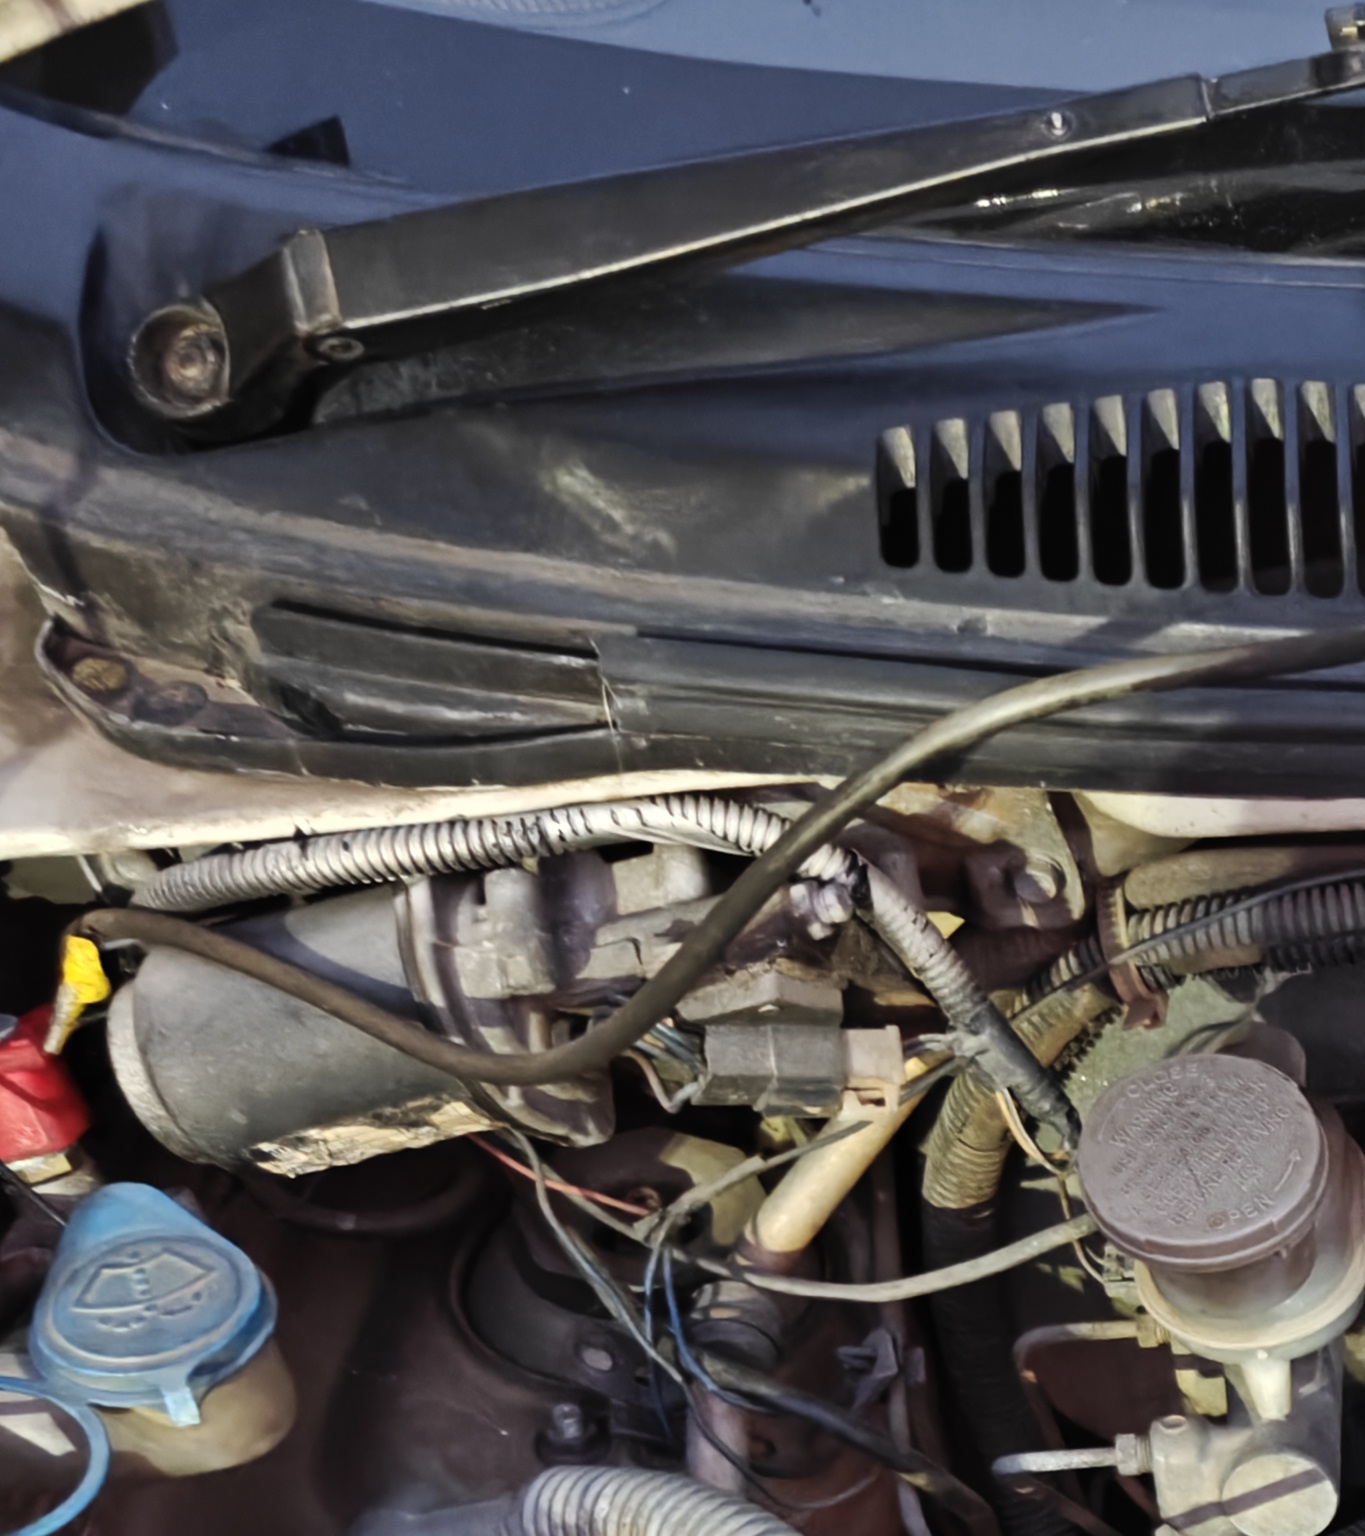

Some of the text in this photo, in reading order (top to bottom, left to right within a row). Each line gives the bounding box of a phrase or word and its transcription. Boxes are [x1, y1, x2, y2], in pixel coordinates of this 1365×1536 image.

[1126, 1062, 1200, 1099] CLOSE
[1108, 1081, 1179, 1149] WARNING
[1206, 1192, 1276, 1230] OPEN
